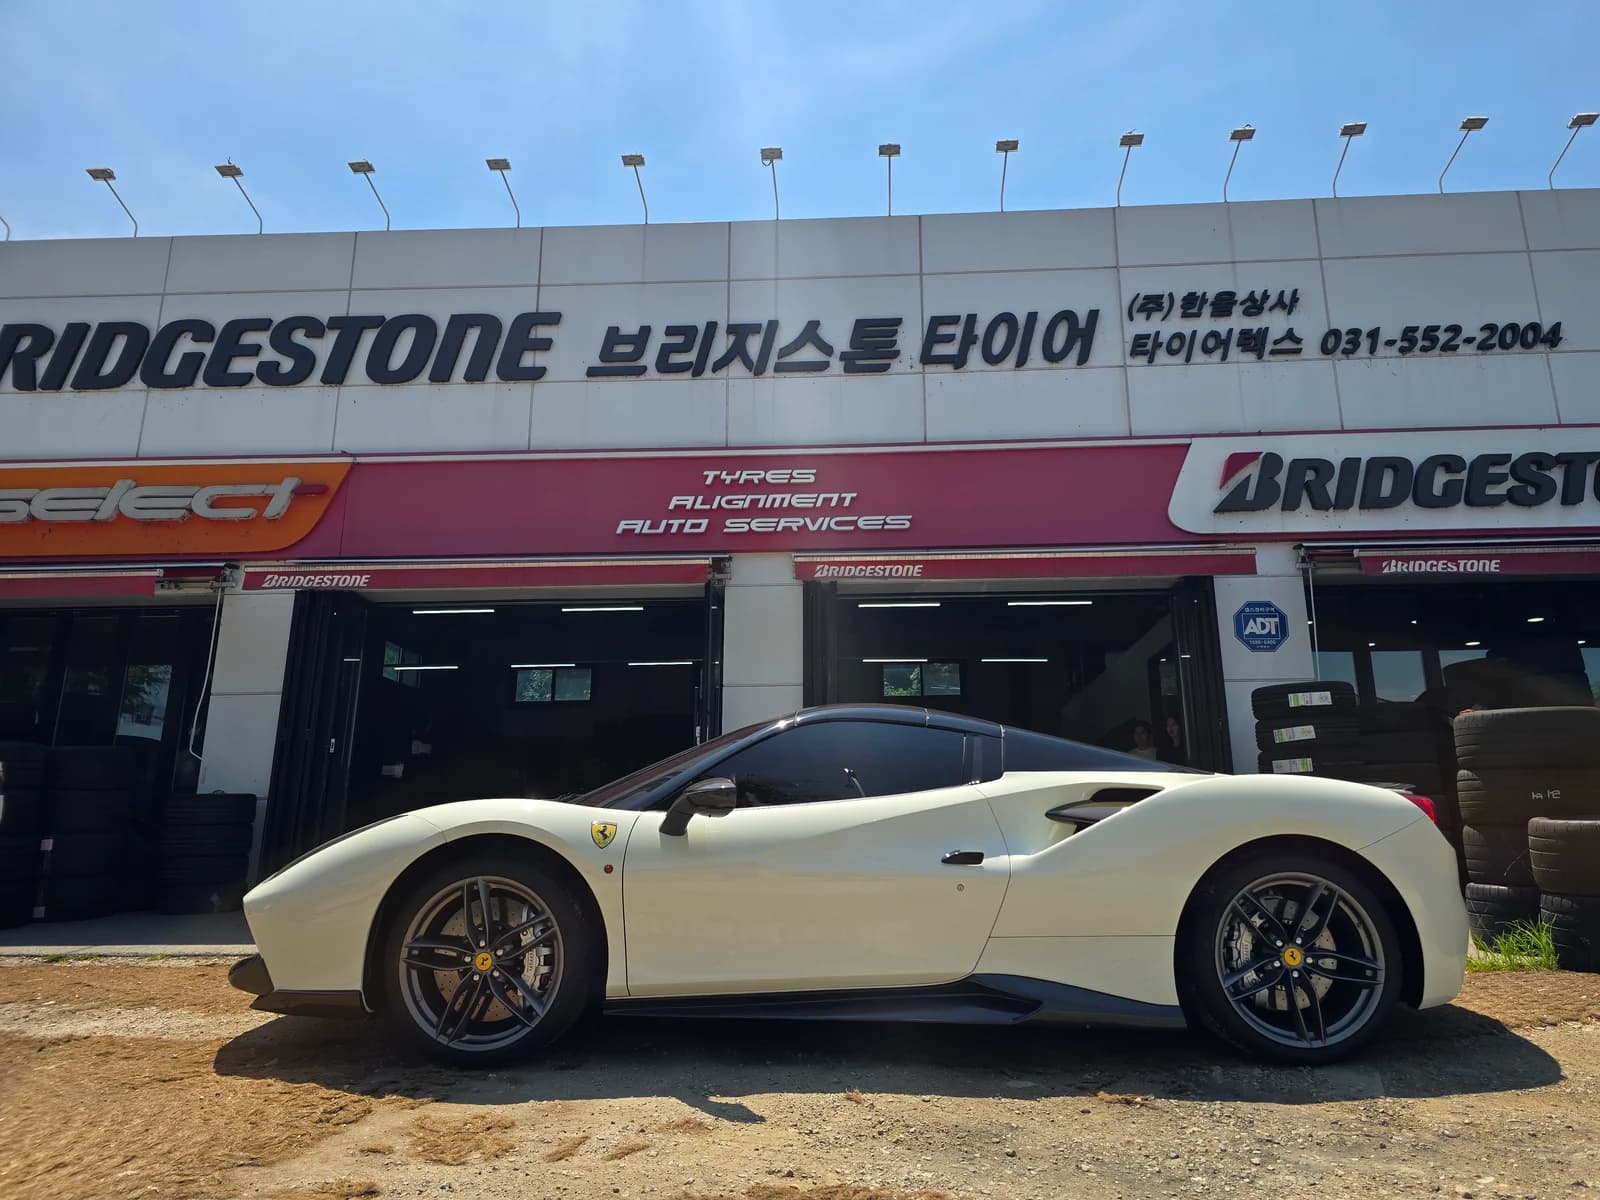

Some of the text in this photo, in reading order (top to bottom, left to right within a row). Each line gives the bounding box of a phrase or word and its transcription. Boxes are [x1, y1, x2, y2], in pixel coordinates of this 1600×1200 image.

[586, 309, 1100, 377] 브리지스톤 타이어
[1320, 321, 1563, 356] 031-552-2004
[703, 469, 817, 485] TYRES
[1213, 452, 1600, 513] BRIDGEST
[668, 493, 858, 510] ALIGNMENT
[615, 515, 913, 535] AUTO SERVICES
[813, 564, 923, 578] BRIDGESTONE
[1381, 559, 1501, 574] BRIDGESTONE
[261, 574, 371, 588] BRIDGESTONE
[1243, 617, 1280, 635] ADT
